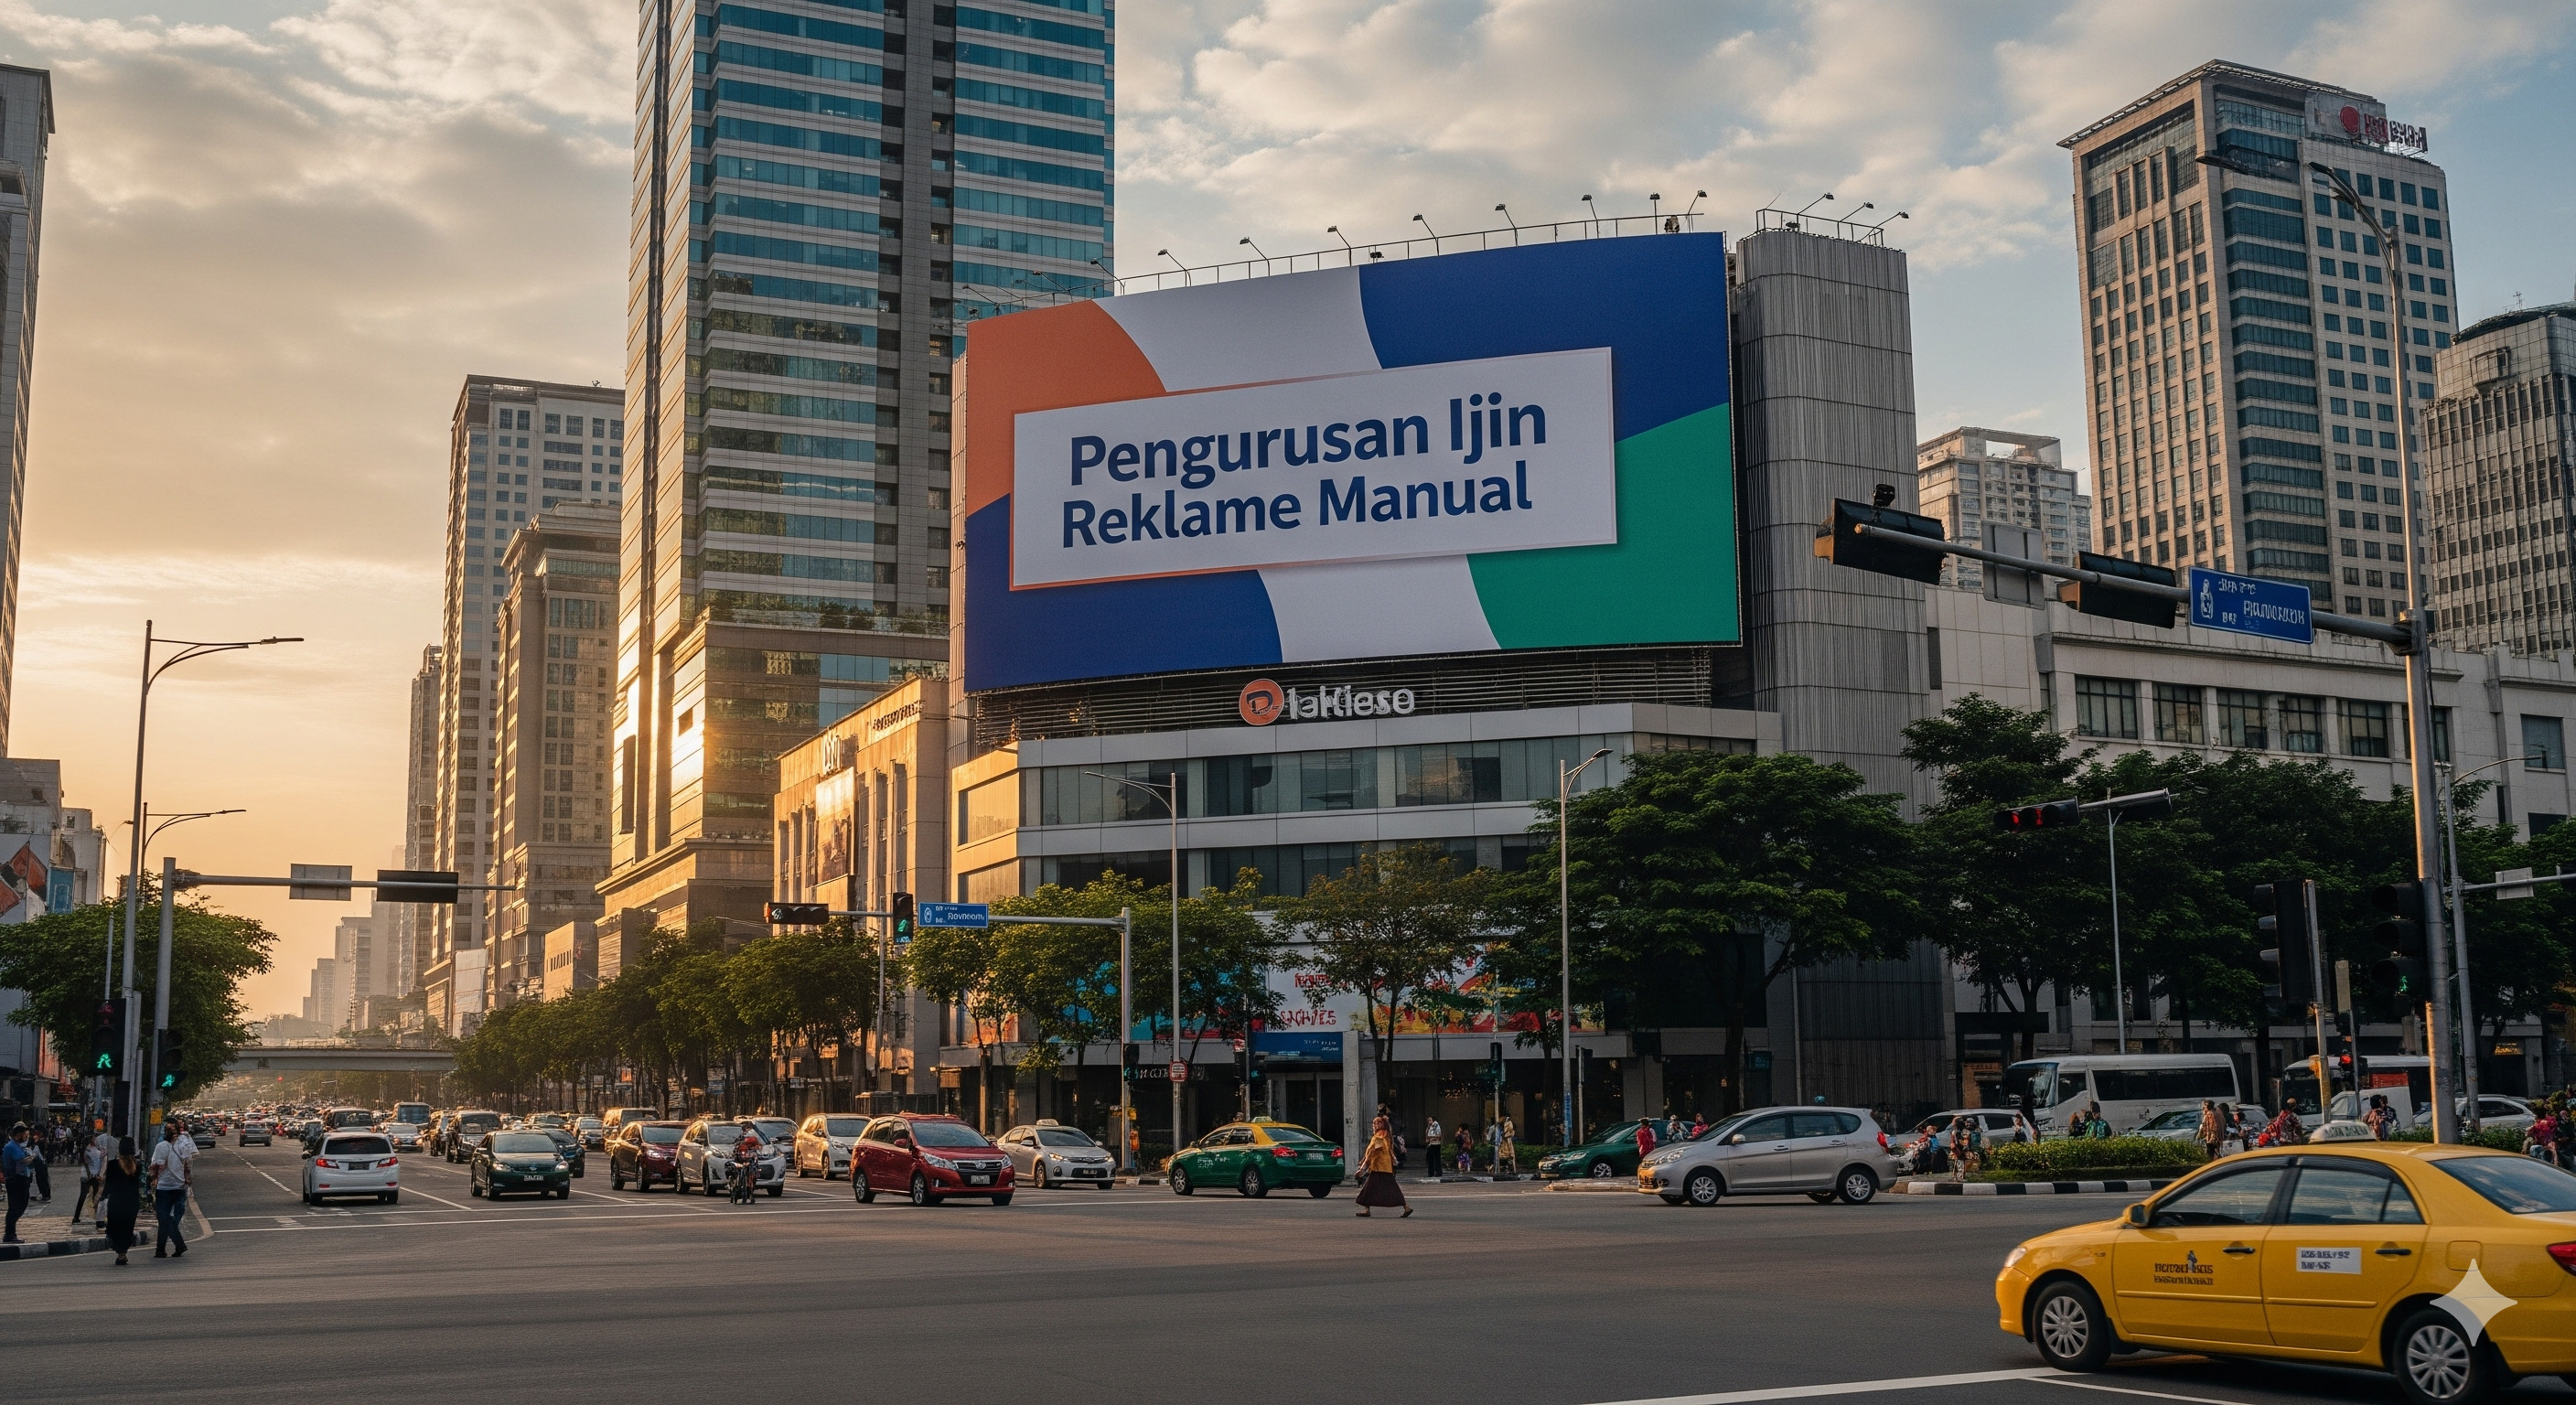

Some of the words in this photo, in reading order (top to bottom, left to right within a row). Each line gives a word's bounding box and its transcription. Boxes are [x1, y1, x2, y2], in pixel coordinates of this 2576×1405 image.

[1070, 414, 1429, 490] Pengurusan
[1449, 391, 1548, 465] Ijin
[1062, 488, 1303, 549] Reklame
[1319, 459, 1533, 526] Manual
